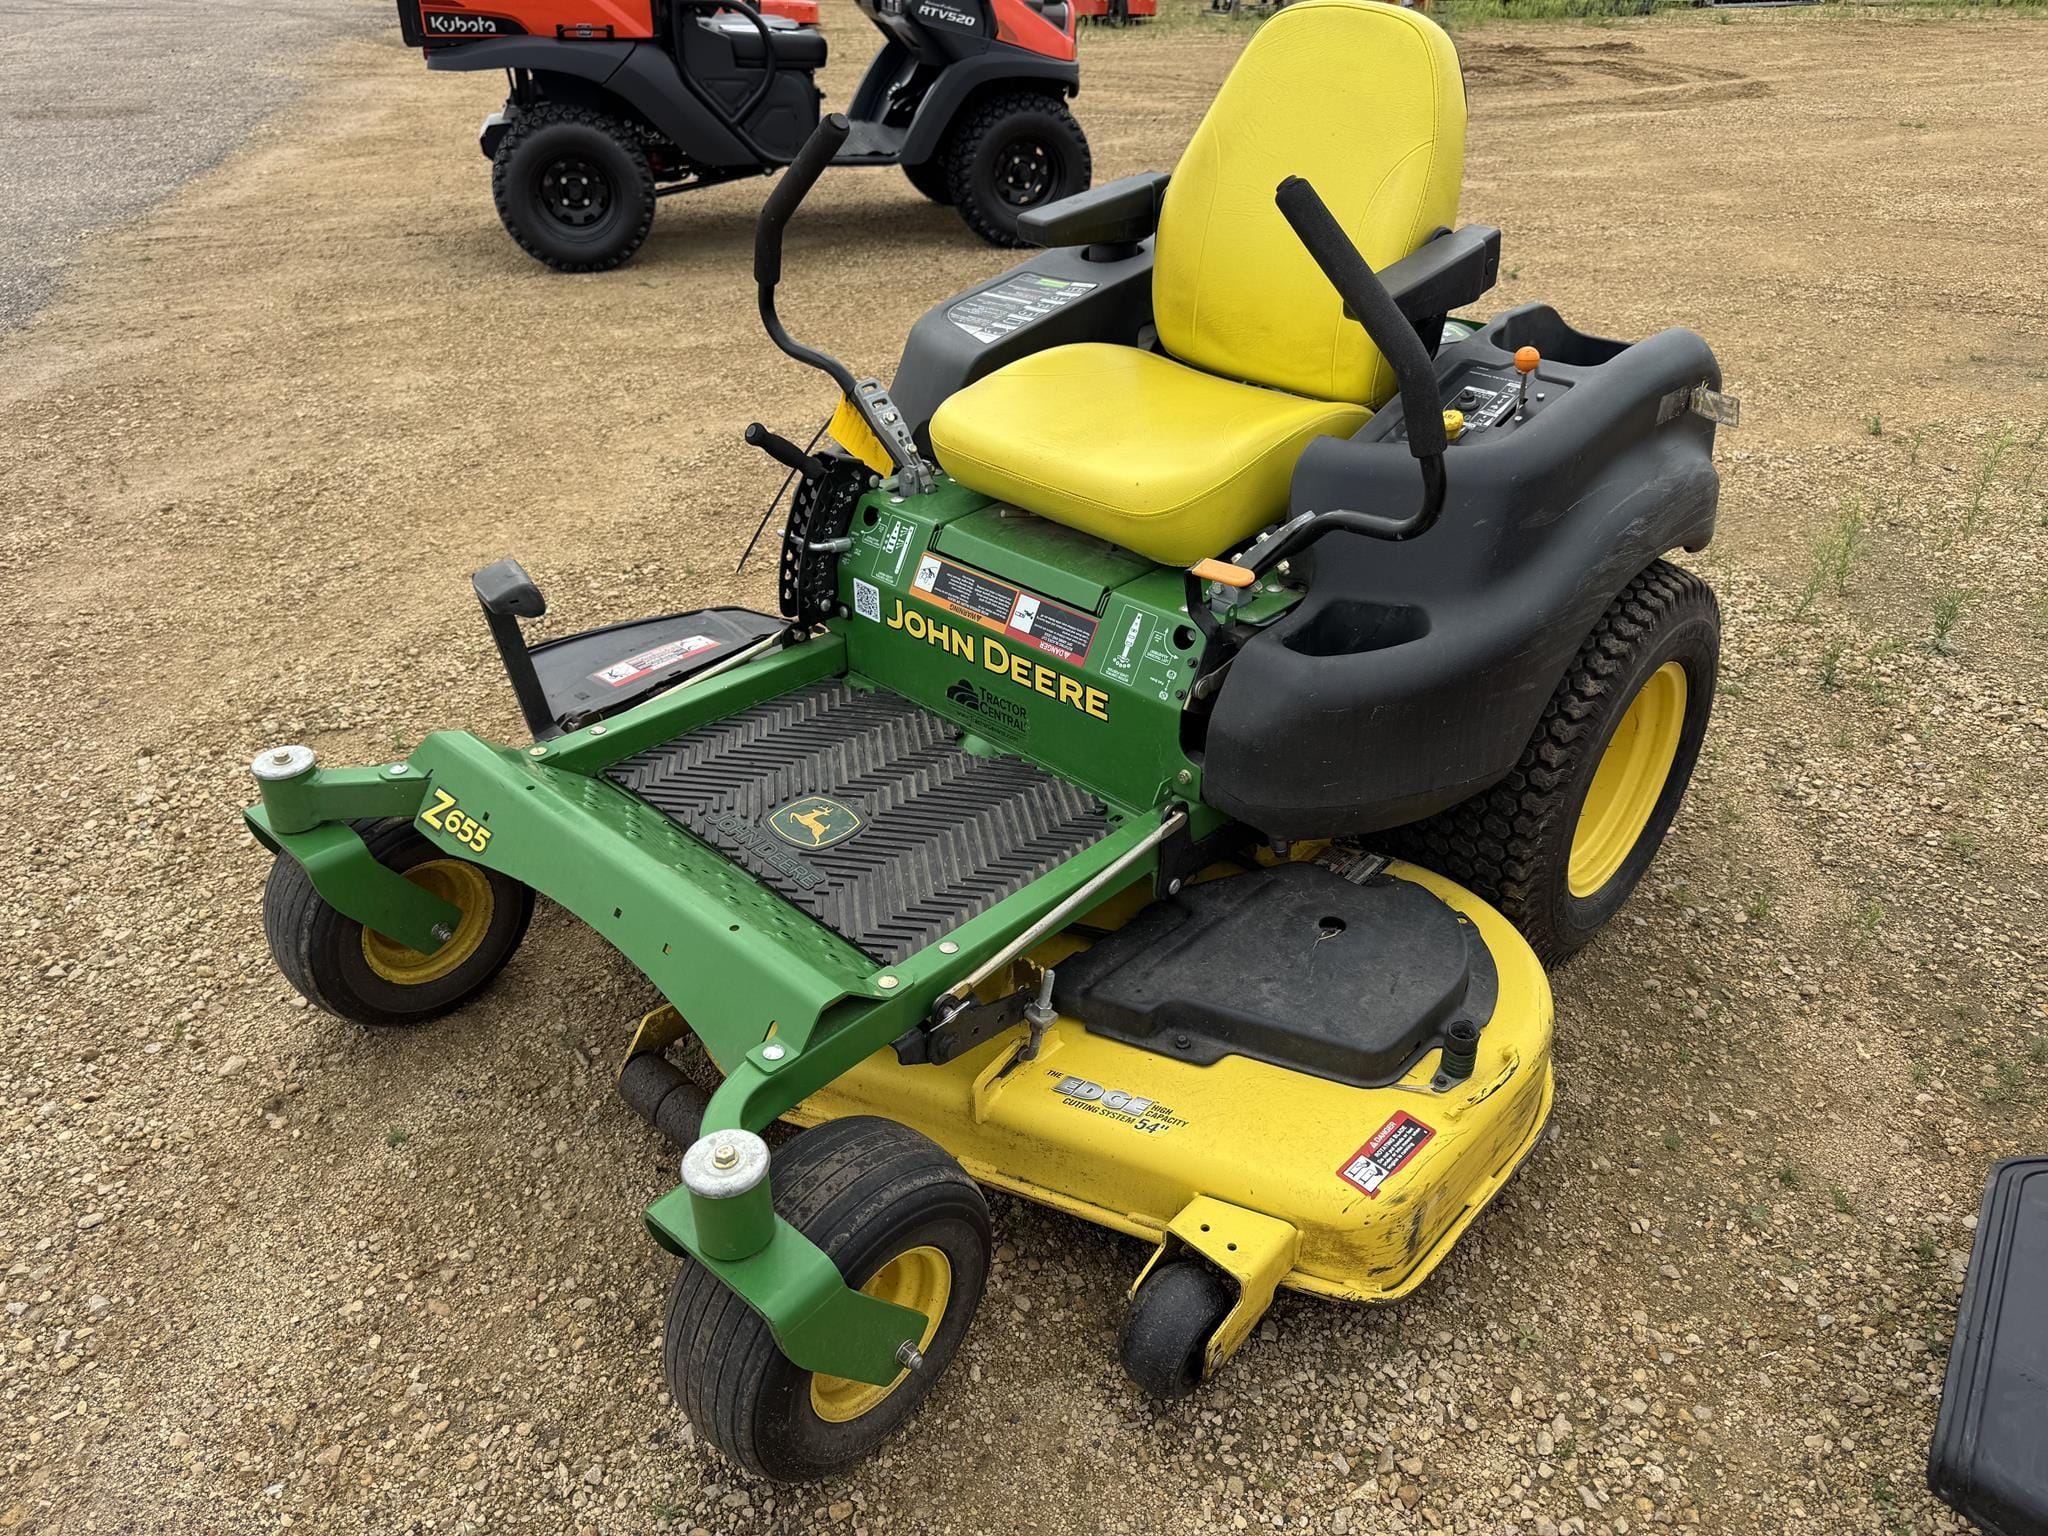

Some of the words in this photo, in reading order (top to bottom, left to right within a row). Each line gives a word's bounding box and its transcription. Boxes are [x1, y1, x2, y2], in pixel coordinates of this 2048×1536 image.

[430, 16, 497, 33] Kubota
[918, 5, 976, 26] RTV520
[948, 603, 976, 620] WARNING
[1038, 640, 1064, 657] DANGER
[886, 599, 974, 662] JOHN
[983, 636, 1109, 722] DEERE
[979, 686, 1026, 719] TRACTOR
[980, 701, 1026, 733] CENTRAL
[421, 788, 492, 852] Z655
[706, 814, 762, 851] JOHN
[752, 842, 824, 889] DEERE
[1047, 1070, 1063, 1079] THE
[1051, 1076, 1153, 1116] EDGE
[1062, 1097, 1099, 1113] CUTTING
[1098, 1109, 1136, 1125] SYSTEM
[1145, 1111, 1189, 1128] CAPACITY
[1151, 1104, 1174, 1116] HIGH
[1374, 1121, 1397, 1142] DANGER
